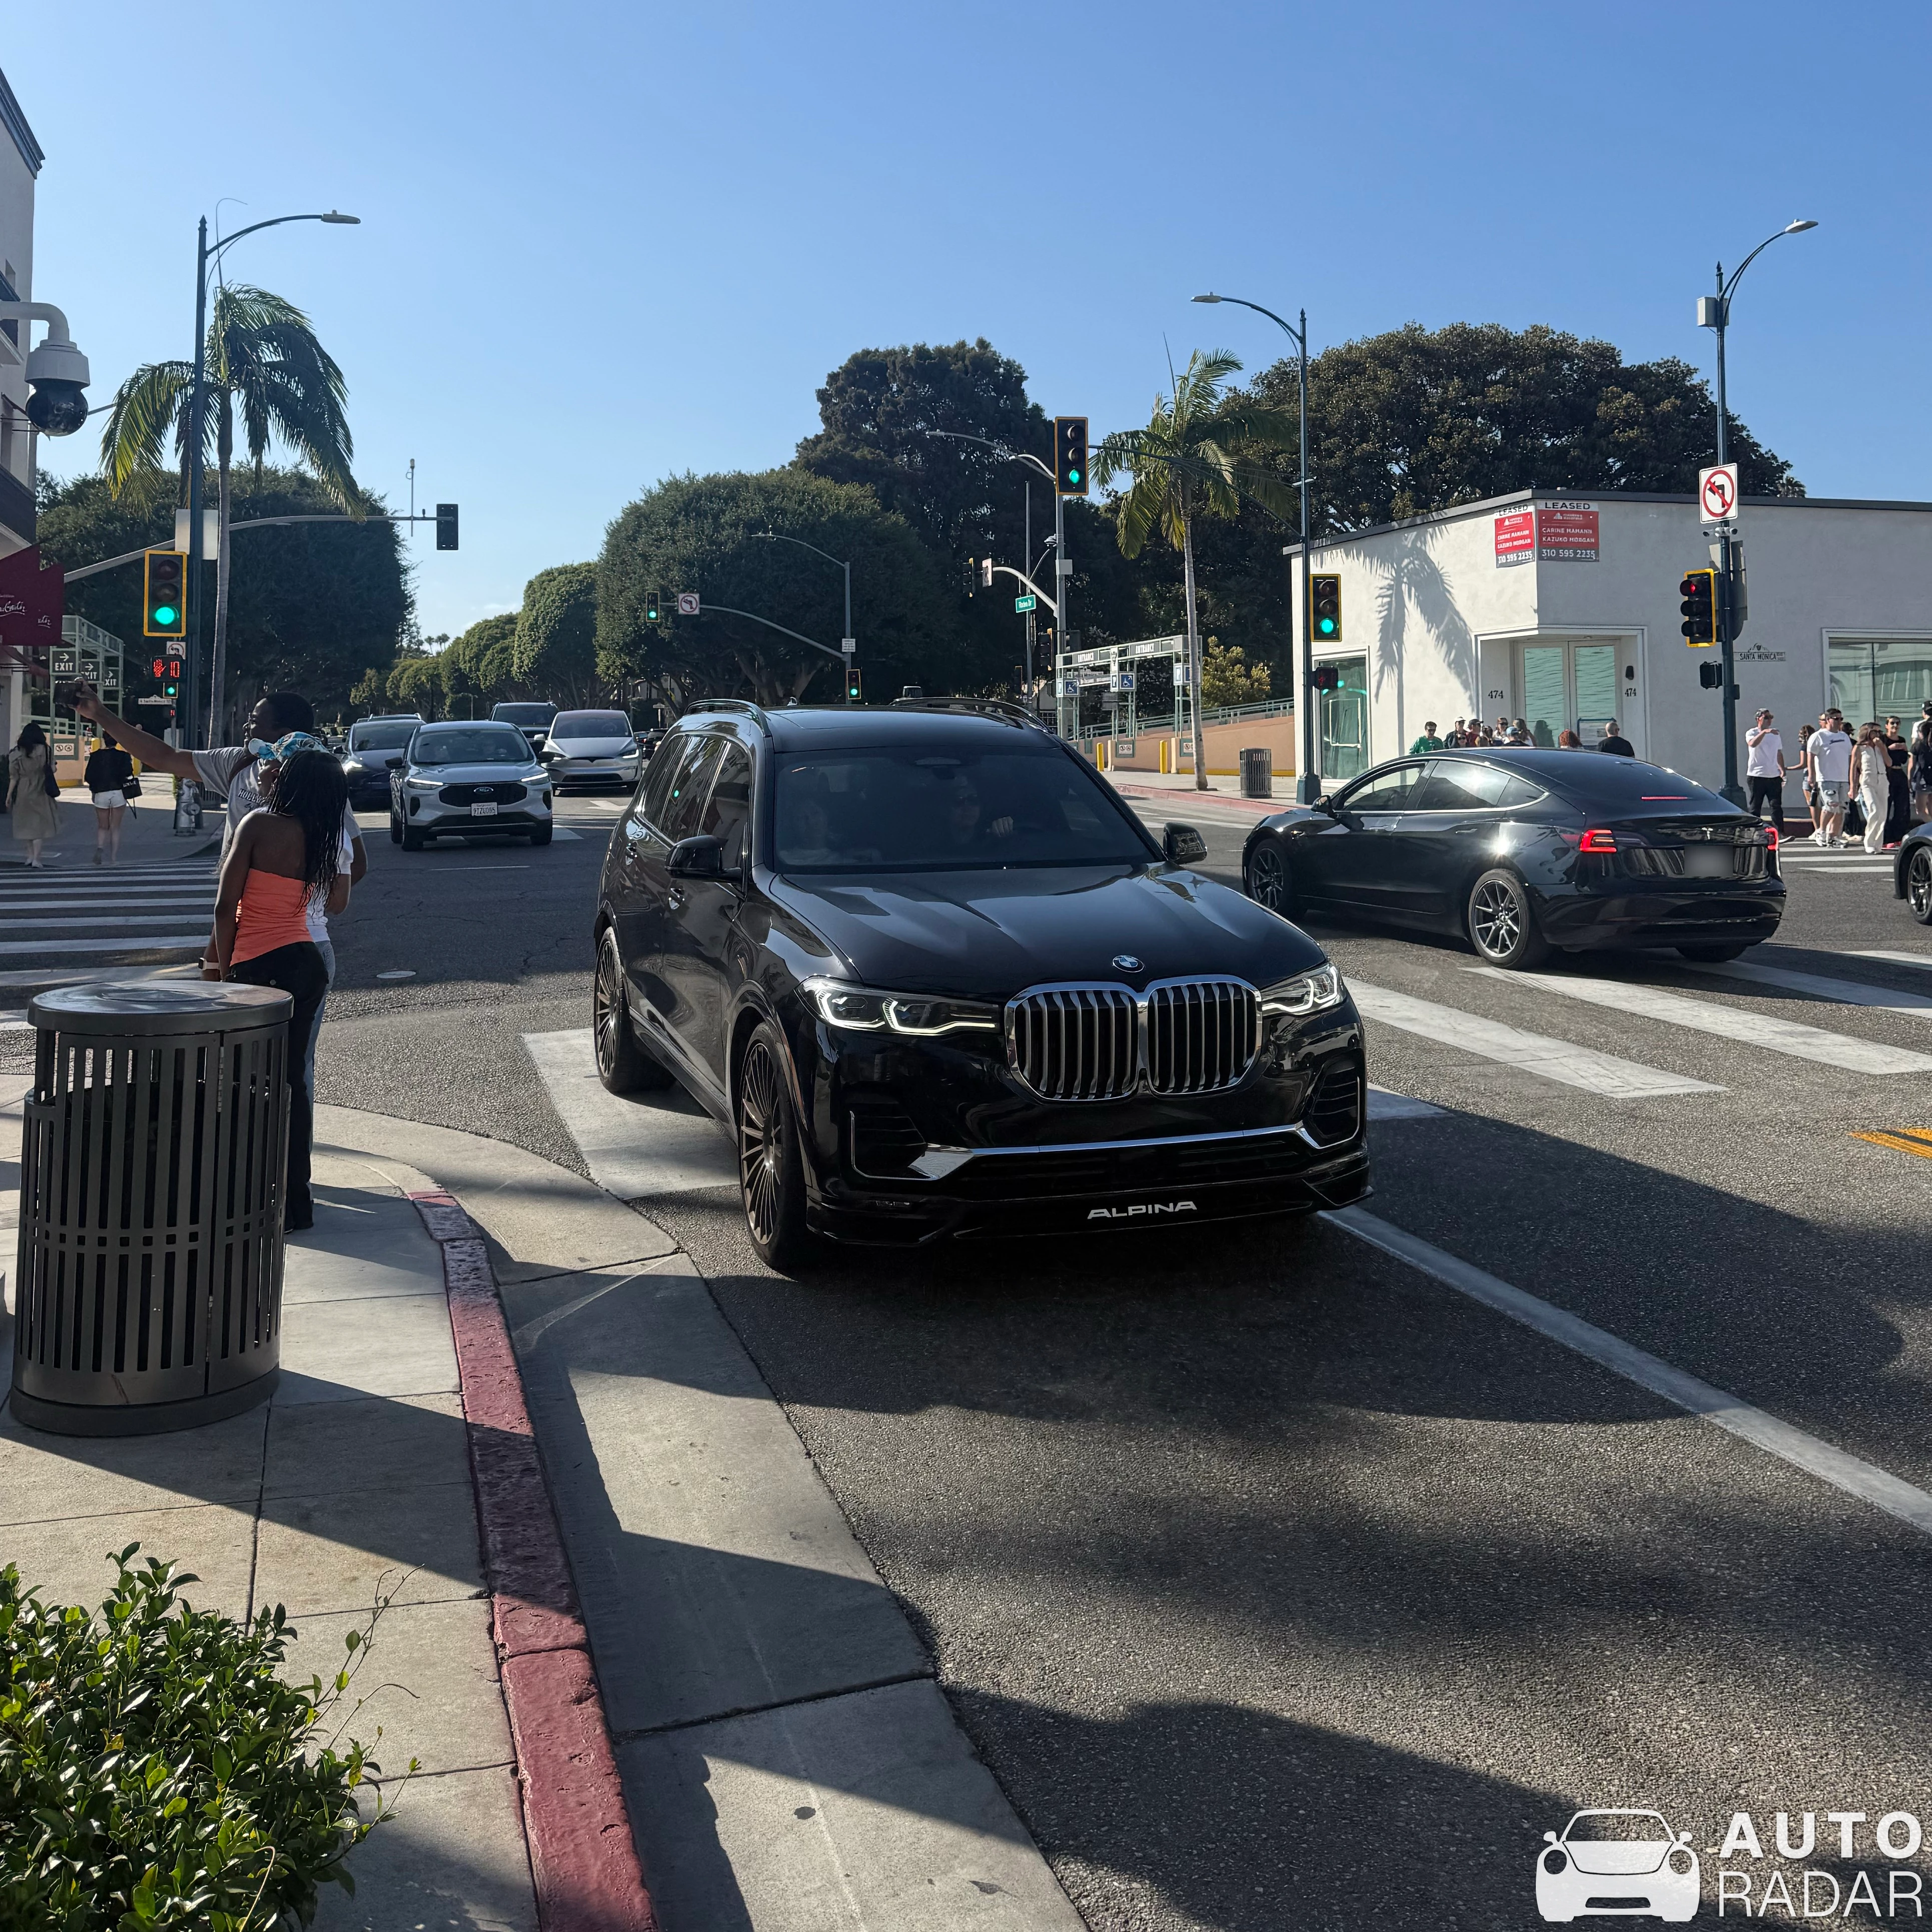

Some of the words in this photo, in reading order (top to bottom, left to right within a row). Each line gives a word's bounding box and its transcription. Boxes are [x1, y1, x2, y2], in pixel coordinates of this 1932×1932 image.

[1499, 504, 1528, 516] LEASED
[1498, 555, 1506, 563] 310
[1507, 553, 1517, 562] 595
[1518, 550, 1532, 560] 2235
[55, 663, 74, 671] EXIT
[1488, 690, 1504, 699] 474
[1625, 688, 1637, 697] 474
[1087, 1201, 1198, 1220] ALPINA
